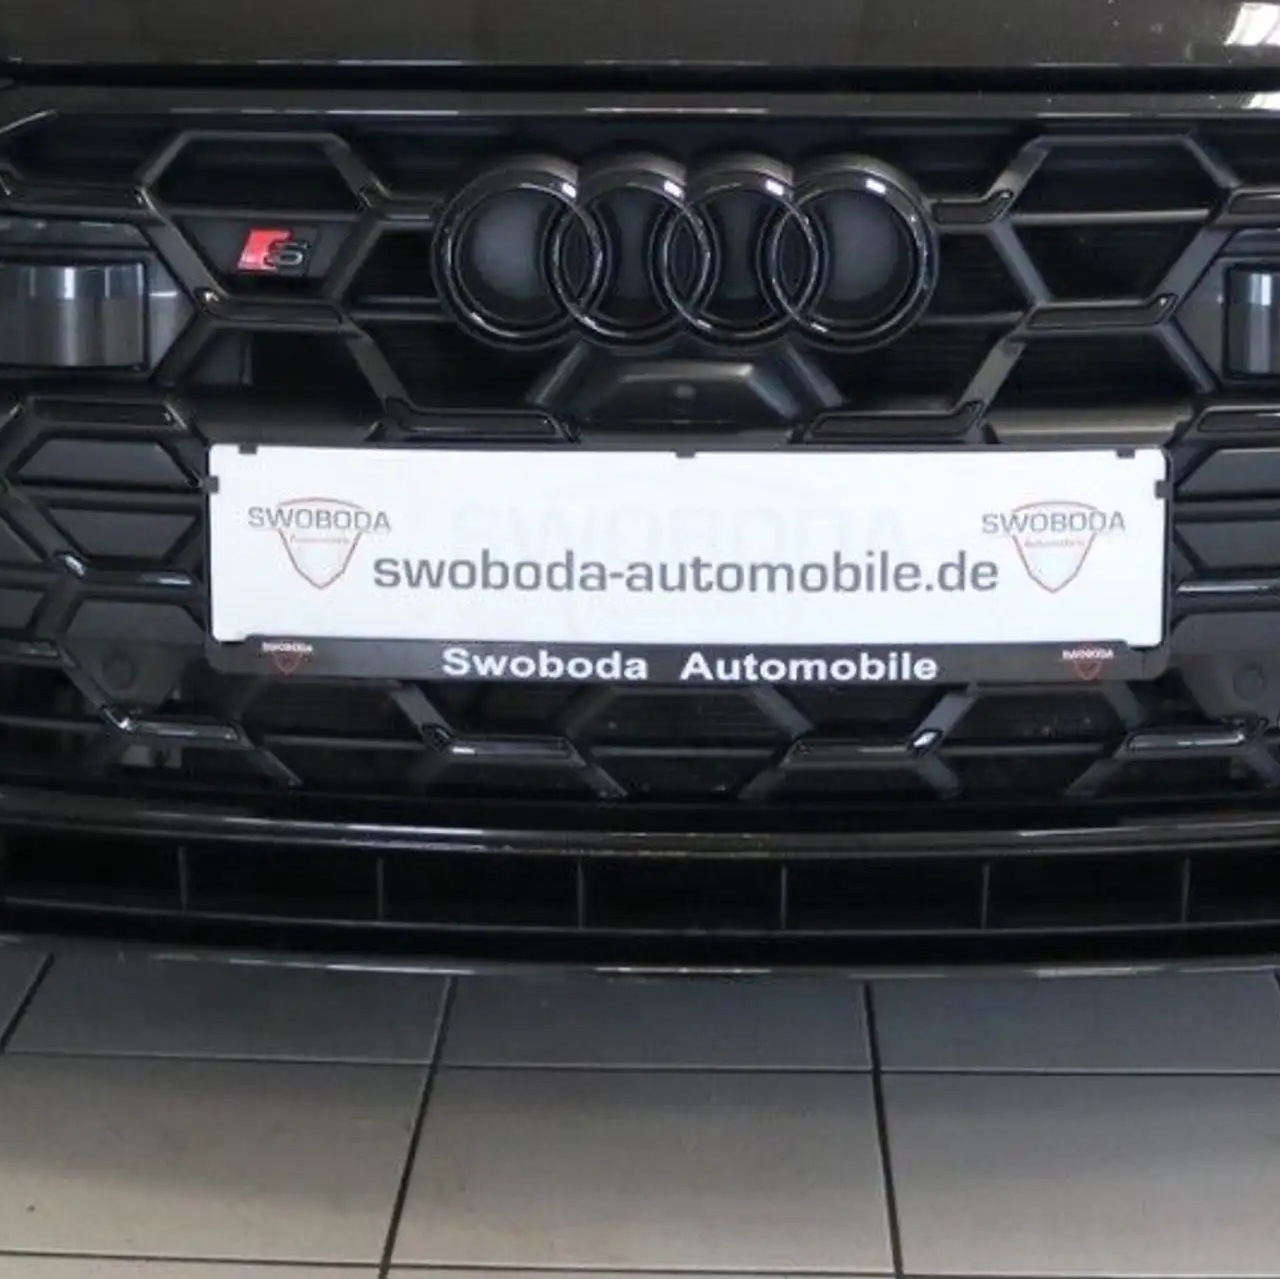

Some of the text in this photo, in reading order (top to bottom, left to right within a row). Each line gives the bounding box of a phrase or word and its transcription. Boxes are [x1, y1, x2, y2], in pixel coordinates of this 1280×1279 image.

[246, 506, 392, 533] SWOBODA
[980, 510, 1126, 535] SWOBODA
[373, 550, 999, 592] swoboda-automobile.de
[442, 647, 938, 682] Swoboda Automobile
